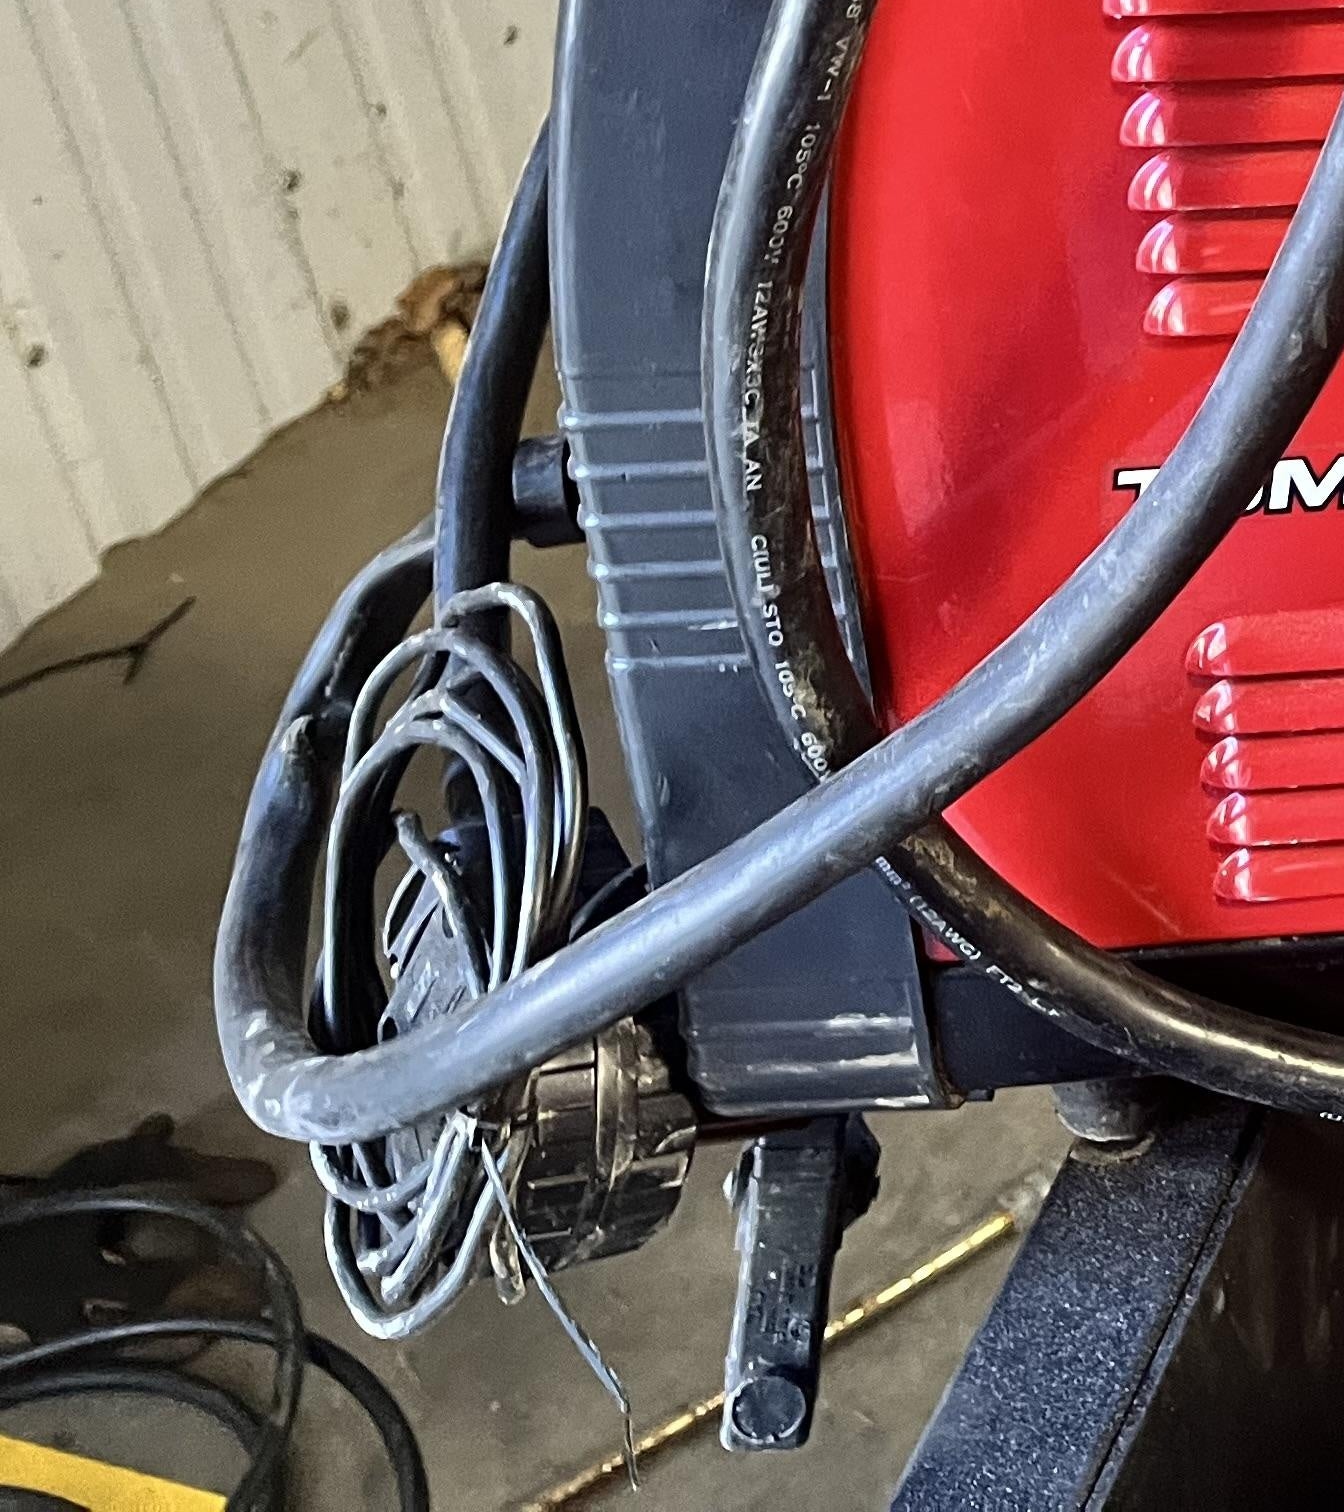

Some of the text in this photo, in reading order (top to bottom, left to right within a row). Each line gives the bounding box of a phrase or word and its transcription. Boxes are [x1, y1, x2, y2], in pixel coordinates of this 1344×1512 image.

[816, 36, 850, 102] VW-1
[787, 121, 821, 191] 105°C
[762, 602, 784, 648] STO
